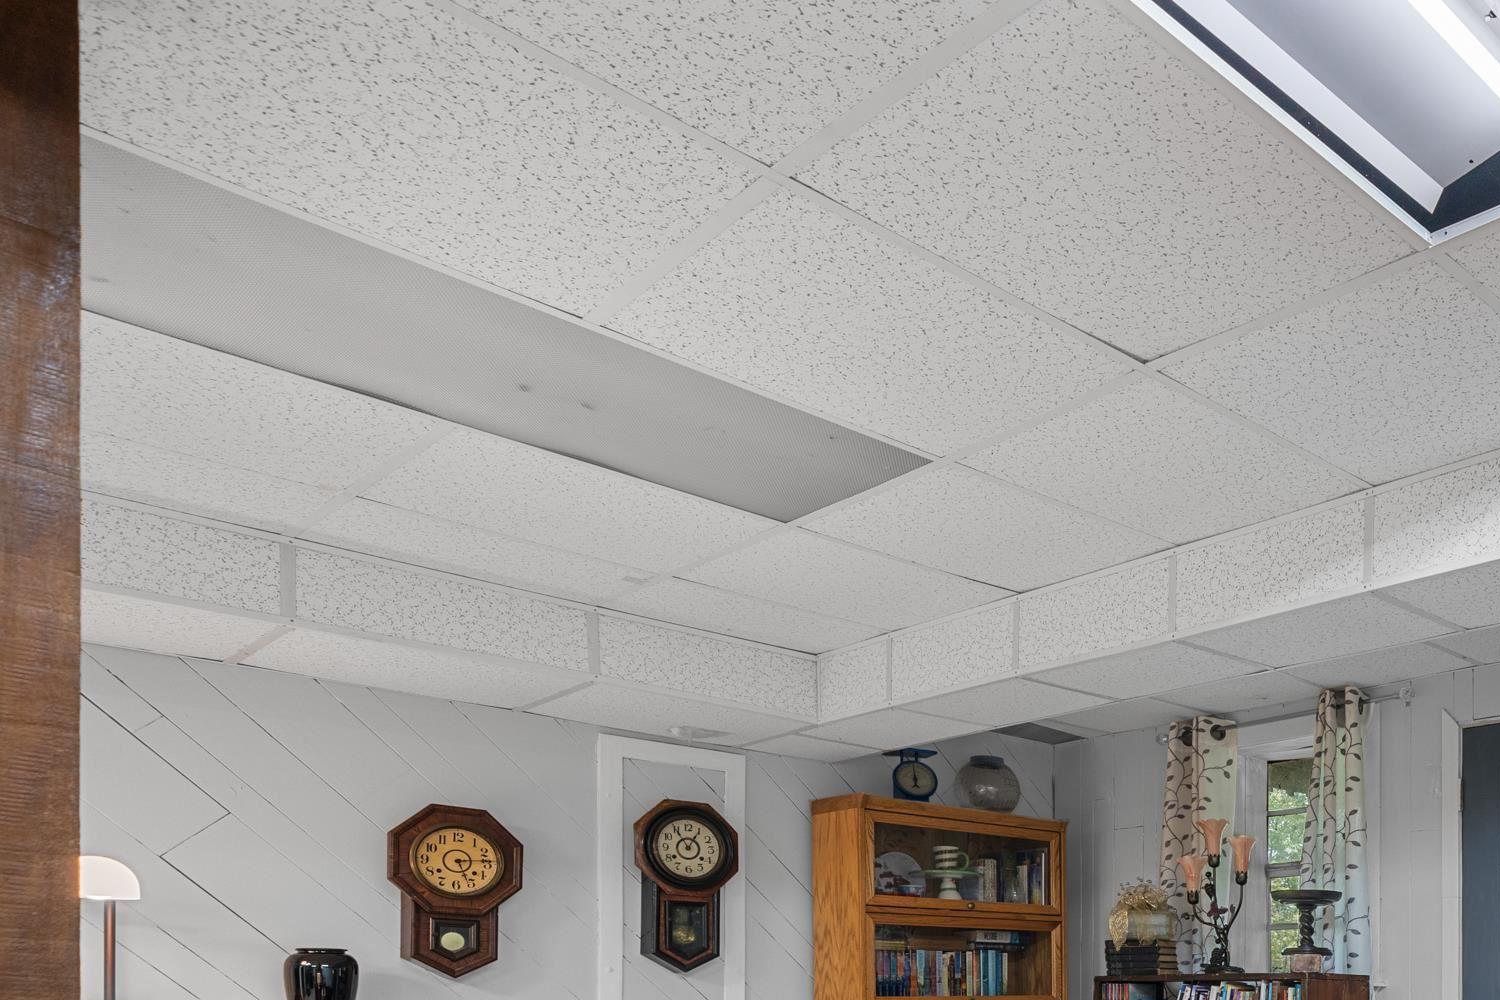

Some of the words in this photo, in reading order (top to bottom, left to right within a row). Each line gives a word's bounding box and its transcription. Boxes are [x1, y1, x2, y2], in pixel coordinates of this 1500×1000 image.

[684, 823, 693, 832] 12
[439, 834, 446, 845] 11
[452, 832, 464, 842] 12
[664, 833, 673, 841] 10
[704, 835, 711, 843] 2
[426, 842, 438, 853] 10
[662, 843, 669, 851] 9
[708, 846, 715, 854] 3
[480, 847, 488, 857] 2
[420, 854, 429, 864] 9
[665, 854, 672, 862] 8
[425, 866, 434, 876] 8
[696, 863, 704, 872] 5
[451, 880, 461, 890] 6
